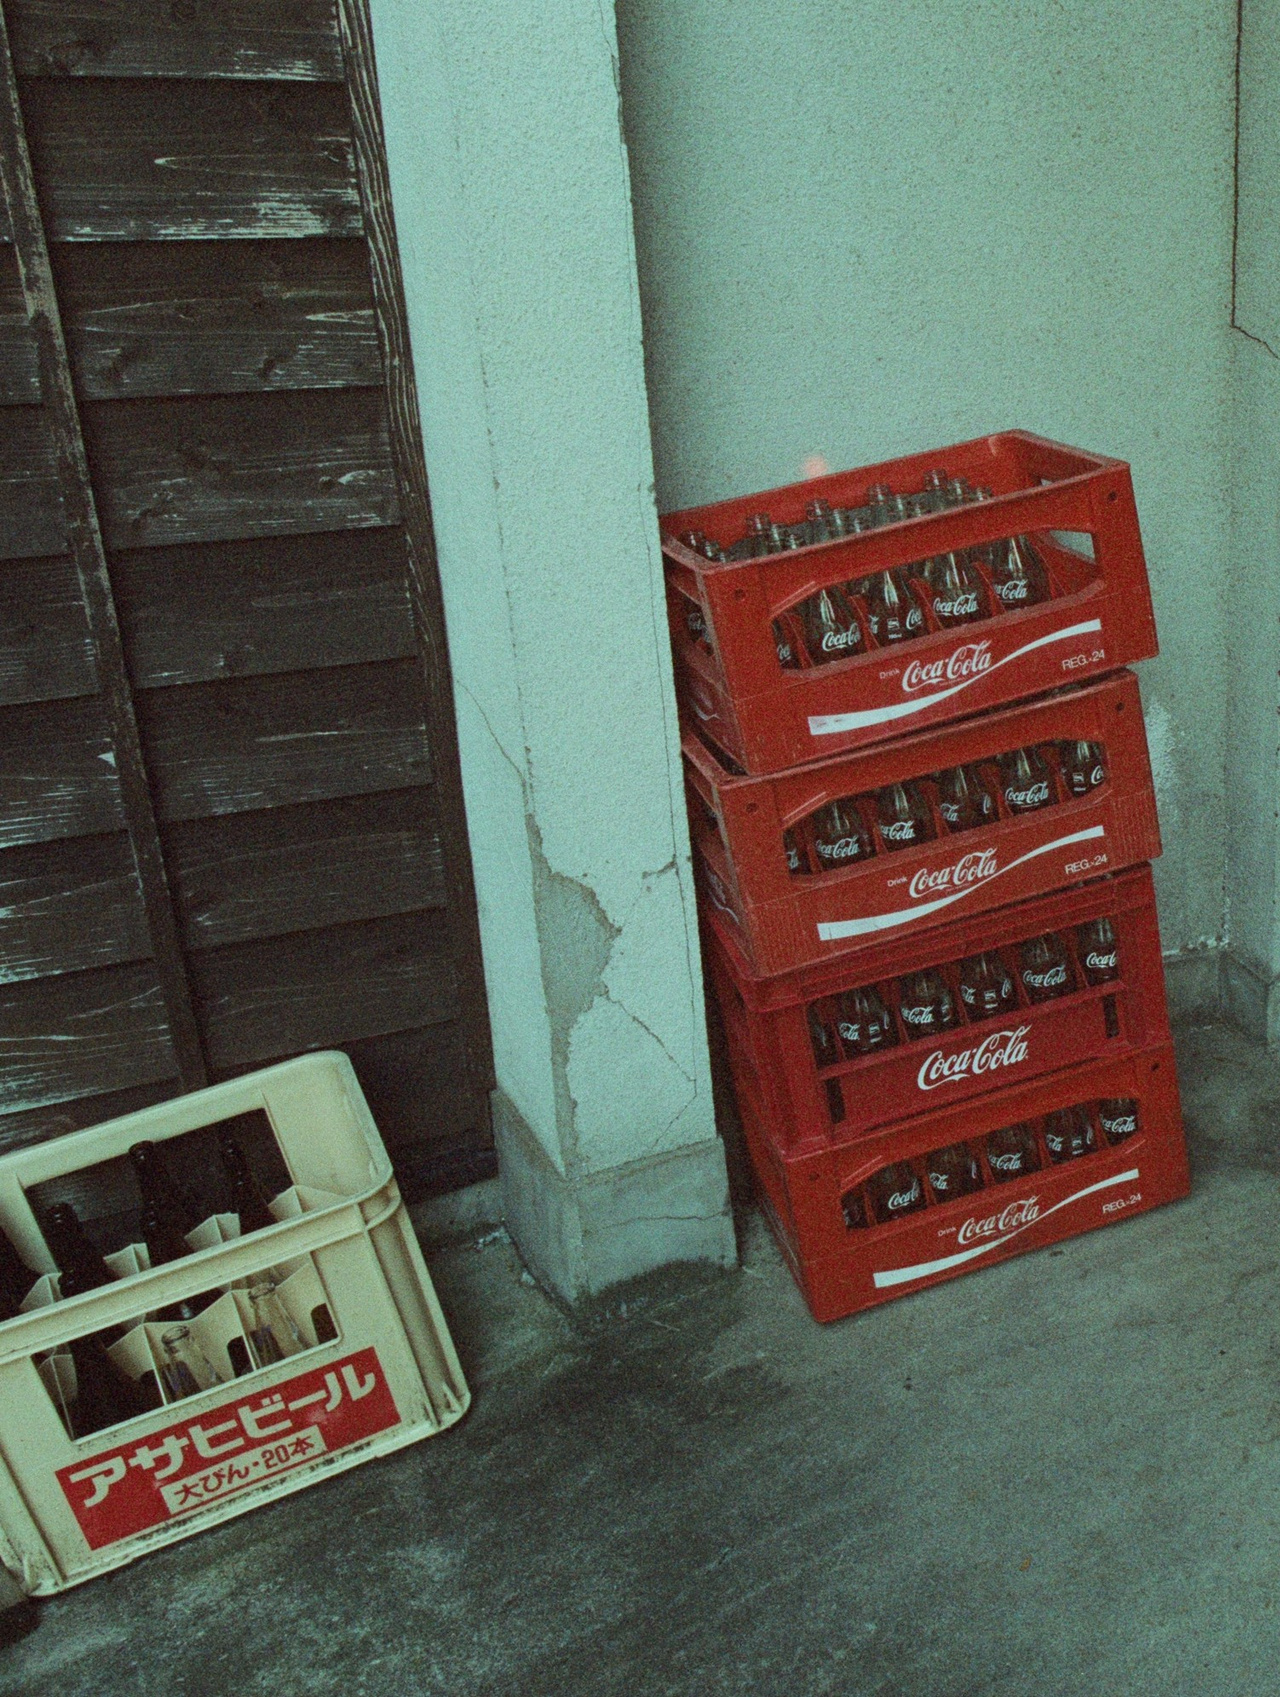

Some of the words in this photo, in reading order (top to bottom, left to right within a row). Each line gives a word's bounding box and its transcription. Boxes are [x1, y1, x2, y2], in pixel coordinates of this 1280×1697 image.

[879, 668, 900, 680] Drink
[902, 639, 992, 693] Coca-Cola
[887, 875, 908, 888] Drink
[908, 847, 998, 899] Coca-Cola
[917, 1023, 1033, 1091] Coca-Cola
[957, 1193, 1042, 1245] Coca-Cola
[69, 1363, 377, 1509] アサヒビール
[173, 1436, 316, 1507] 大びん・20本
